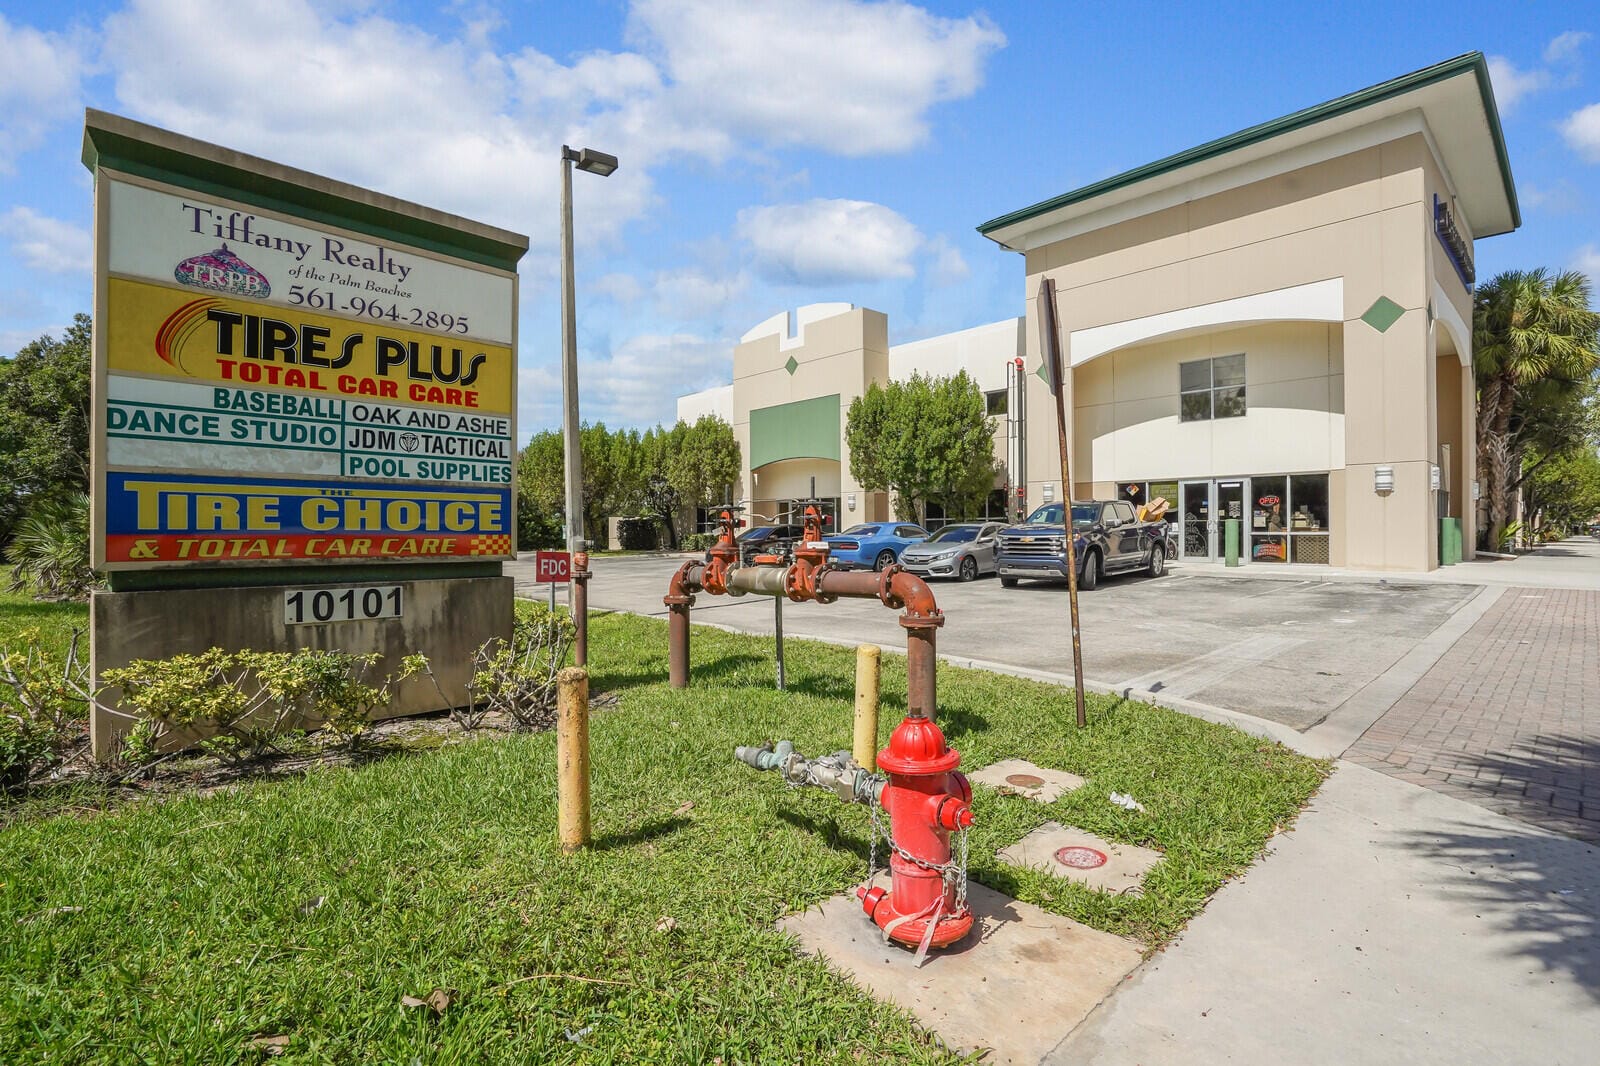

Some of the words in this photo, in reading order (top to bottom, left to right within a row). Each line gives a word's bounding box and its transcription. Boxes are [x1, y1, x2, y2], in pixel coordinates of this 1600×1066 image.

[182, 202, 312, 262] Tiffany
[321, 236, 413, 283] Realty
[187, 261, 262, 293] TRPB
[288, 264, 303, 279] of
[306, 266, 325, 282] the
[329, 272, 361, 290] Palm
[365, 280, 412, 299] Beaches
[287, 284, 469, 334] 561-964-2895
[207, 307, 363, 369] TIRES
[376, 336, 486, 386] PLUS
[216, 358, 328, 390] TOTAL
[337, 374, 399, 398] CAR
[408, 383, 479, 408] CARE
[214, 387, 341, 419] BASEBALL
[352, 404, 402, 426] OAK
[406, 411, 450, 430] AND
[455, 416, 507, 435] ASHE
[106, 407, 220, 437] DANCE
[230, 418, 337, 446] STUDIO
[349, 429, 396, 450] JDM
[421, 434, 508, 459] TACTICAL
[350, 456, 410, 478] POOL
[417, 461, 512, 483] SUPPLIES
[124, 480, 281, 531] TIRE
[301, 498, 502, 532] CHOICE
[1259, 496, 1280, 505] OPEN
[129, 539, 160, 559] &
[176, 539, 292, 559] TOTAL
[304, 538, 372, 556] CAR
[380, 538, 457, 555] CARE
[540, 559, 567, 576] FDC
[287, 587, 401, 622] 10101
